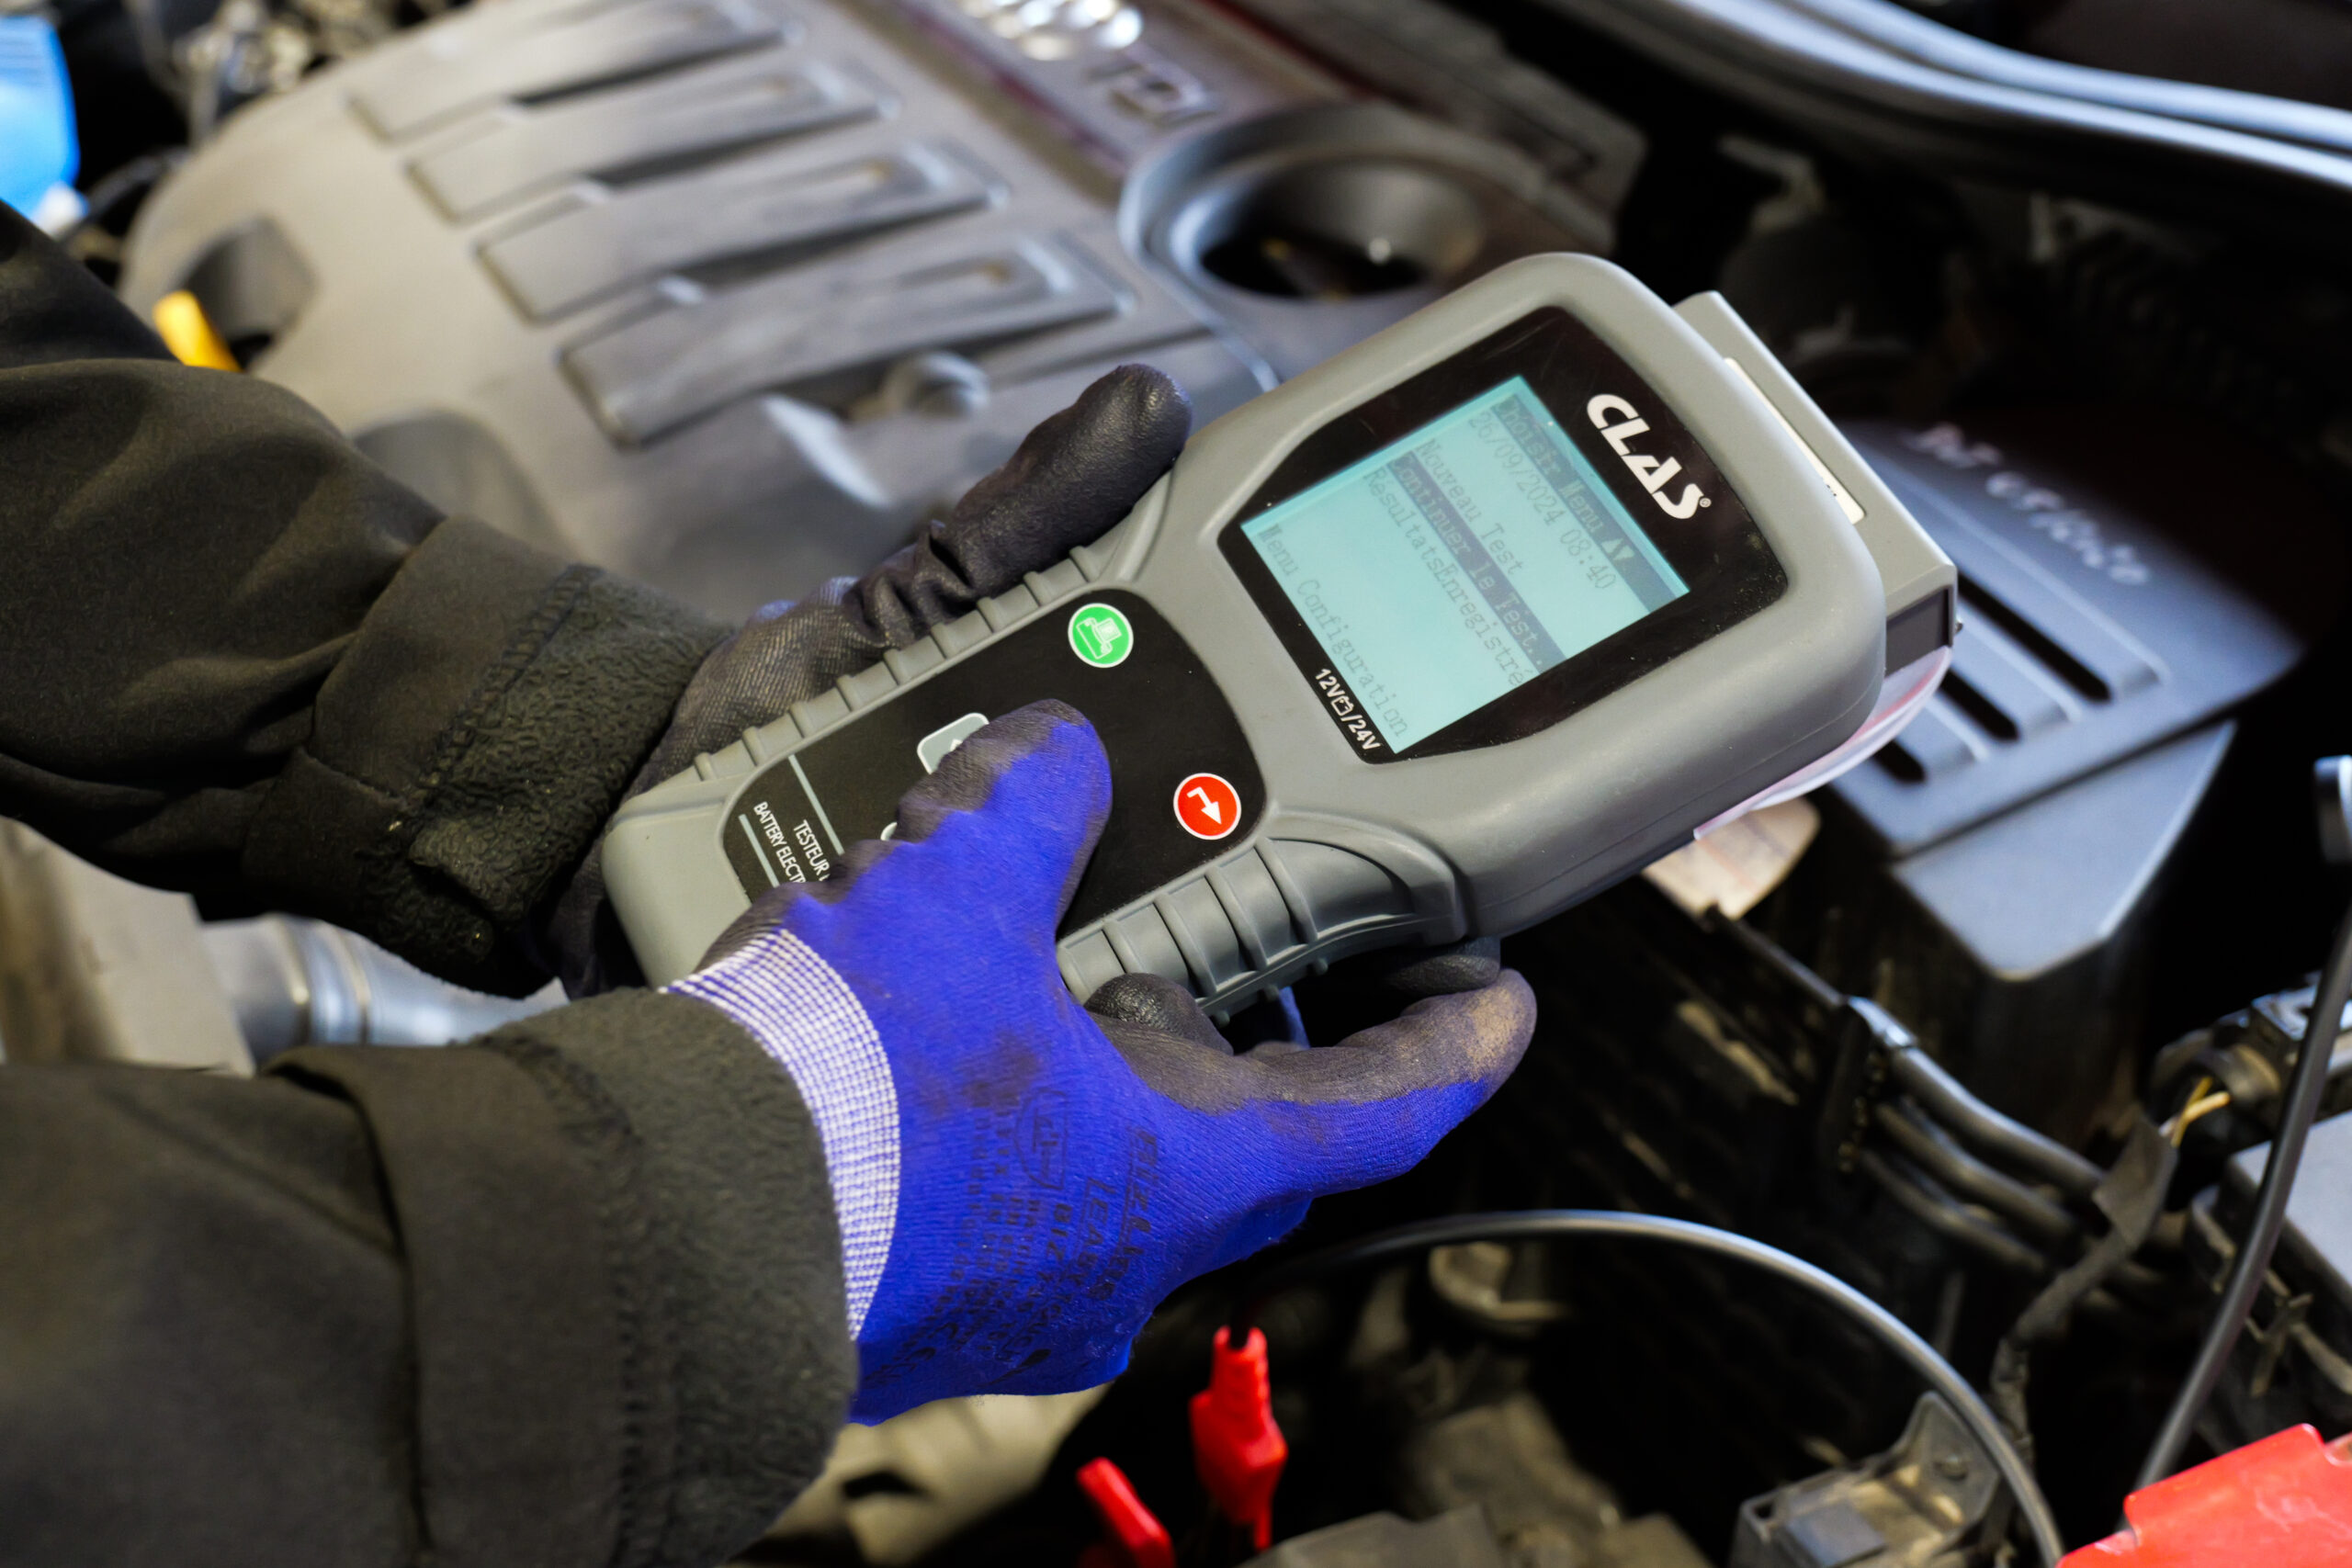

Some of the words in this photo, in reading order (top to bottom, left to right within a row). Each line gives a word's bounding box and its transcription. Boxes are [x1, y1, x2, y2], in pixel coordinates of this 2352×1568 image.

[1390, 452, 1476, 558] Continuer
[1470, 562, 1498, 592] le
[1414, 437, 1483, 524] Nouveau
[1479, 522, 1526, 576] Test
[1467, 409, 1566, 525] 26/09/2024
[1557, 525, 1617, 593] 08:40
[1557, 477, 1609, 534] Menu
[1256, 523, 1300, 577] Menu
[1293, 577, 1411, 739] Configuration
[753, 802, 787, 846] BATTERY
[792, 818, 830, 876] TESTEUR
